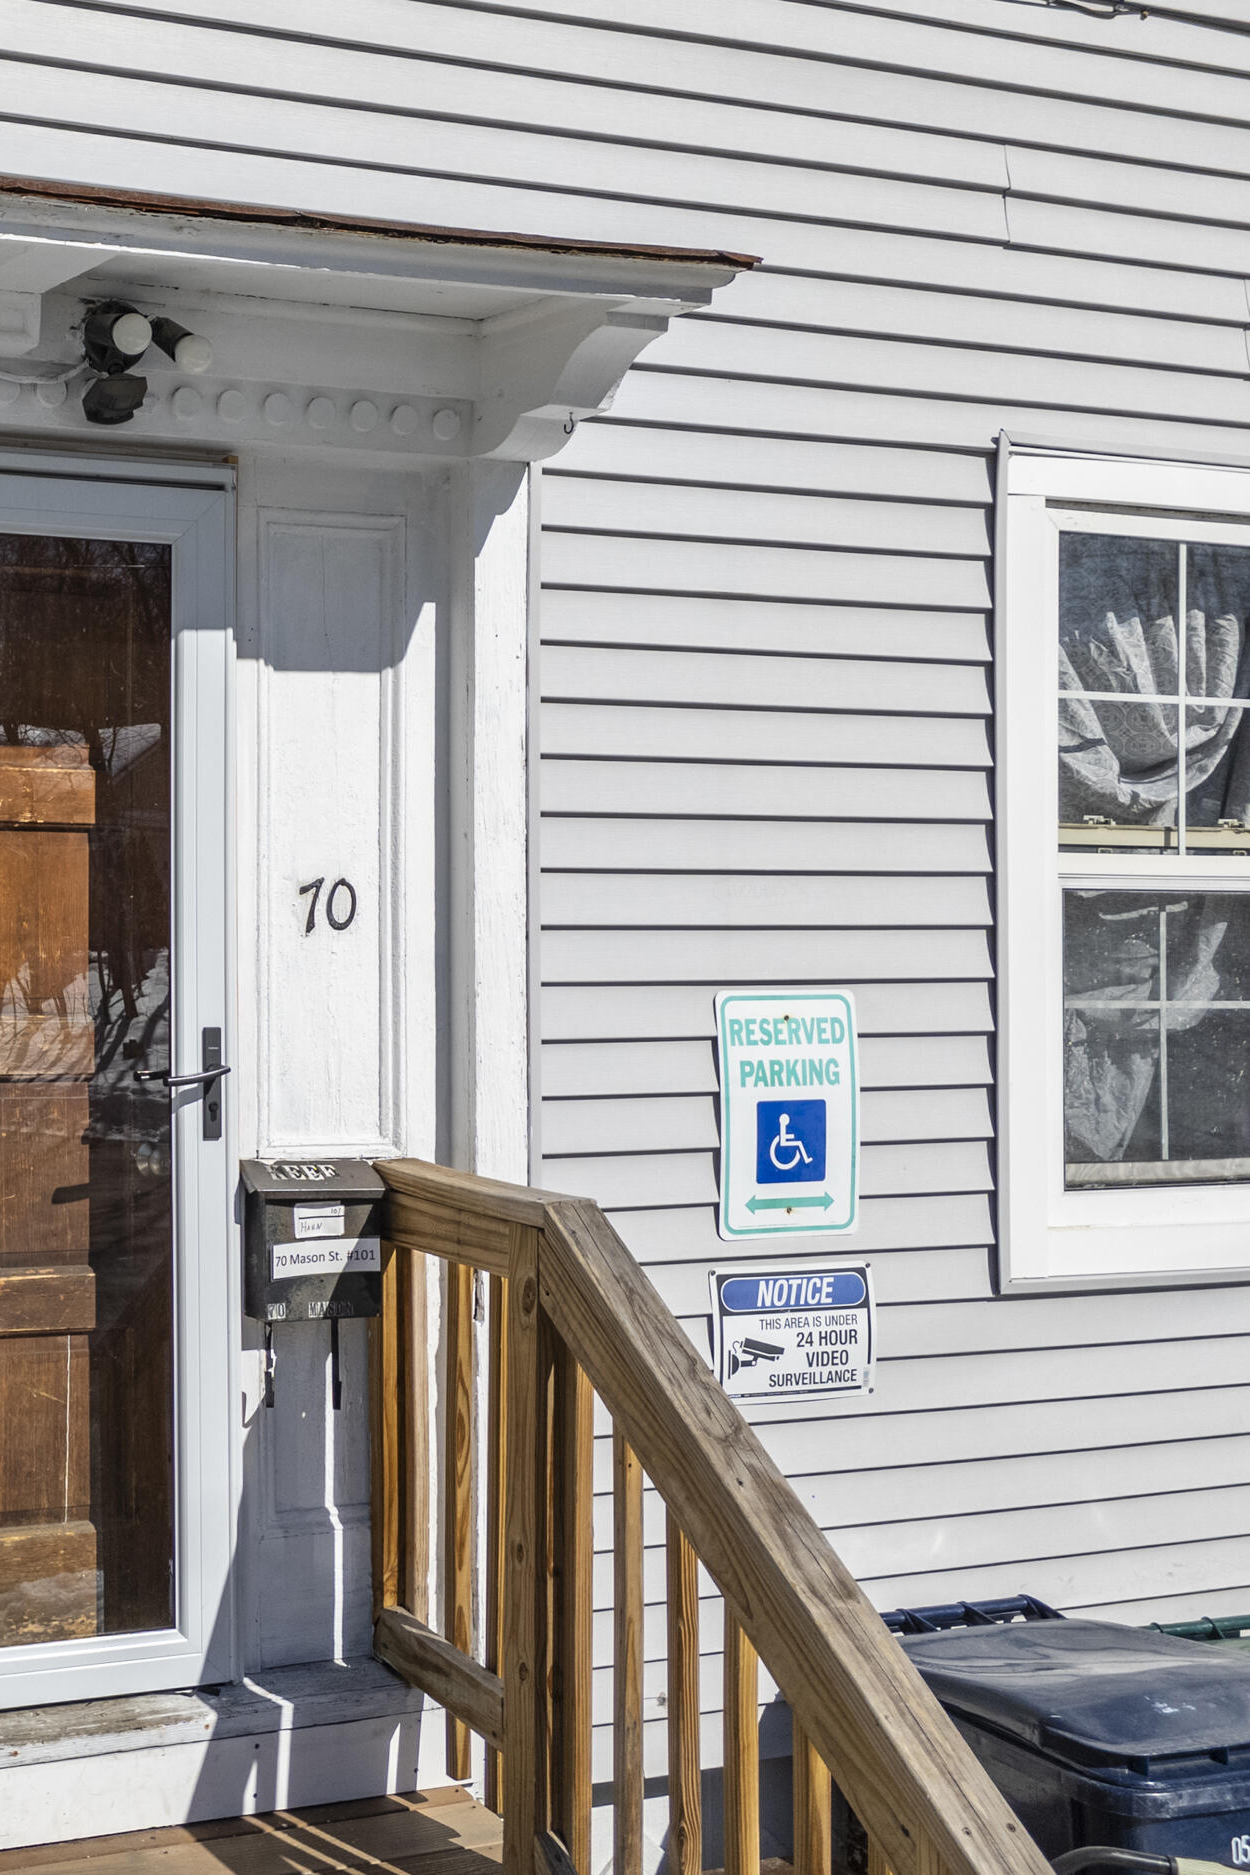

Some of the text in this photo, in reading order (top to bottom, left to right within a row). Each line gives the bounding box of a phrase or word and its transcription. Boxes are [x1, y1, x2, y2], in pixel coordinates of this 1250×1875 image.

[299, 877, 356, 937] 70
[729, 1017, 845, 1046] RESERVED
[740, 1058, 840, 1088] PARKING
[275, 1249, 375, 1267] 70 Mason St. #101
[757, 1277, 834, 1307] NOTICE
[268, 1303, 286, 1320] 70
[759, 1314, 858, 1330] THIS AREA IS UNDER
[796, 1329, 858, 1347] 24 HOUR
[806, 1350, 849, 1367] VIDEO
[769, 1369, 857, 1387] SURVEILLANCE
